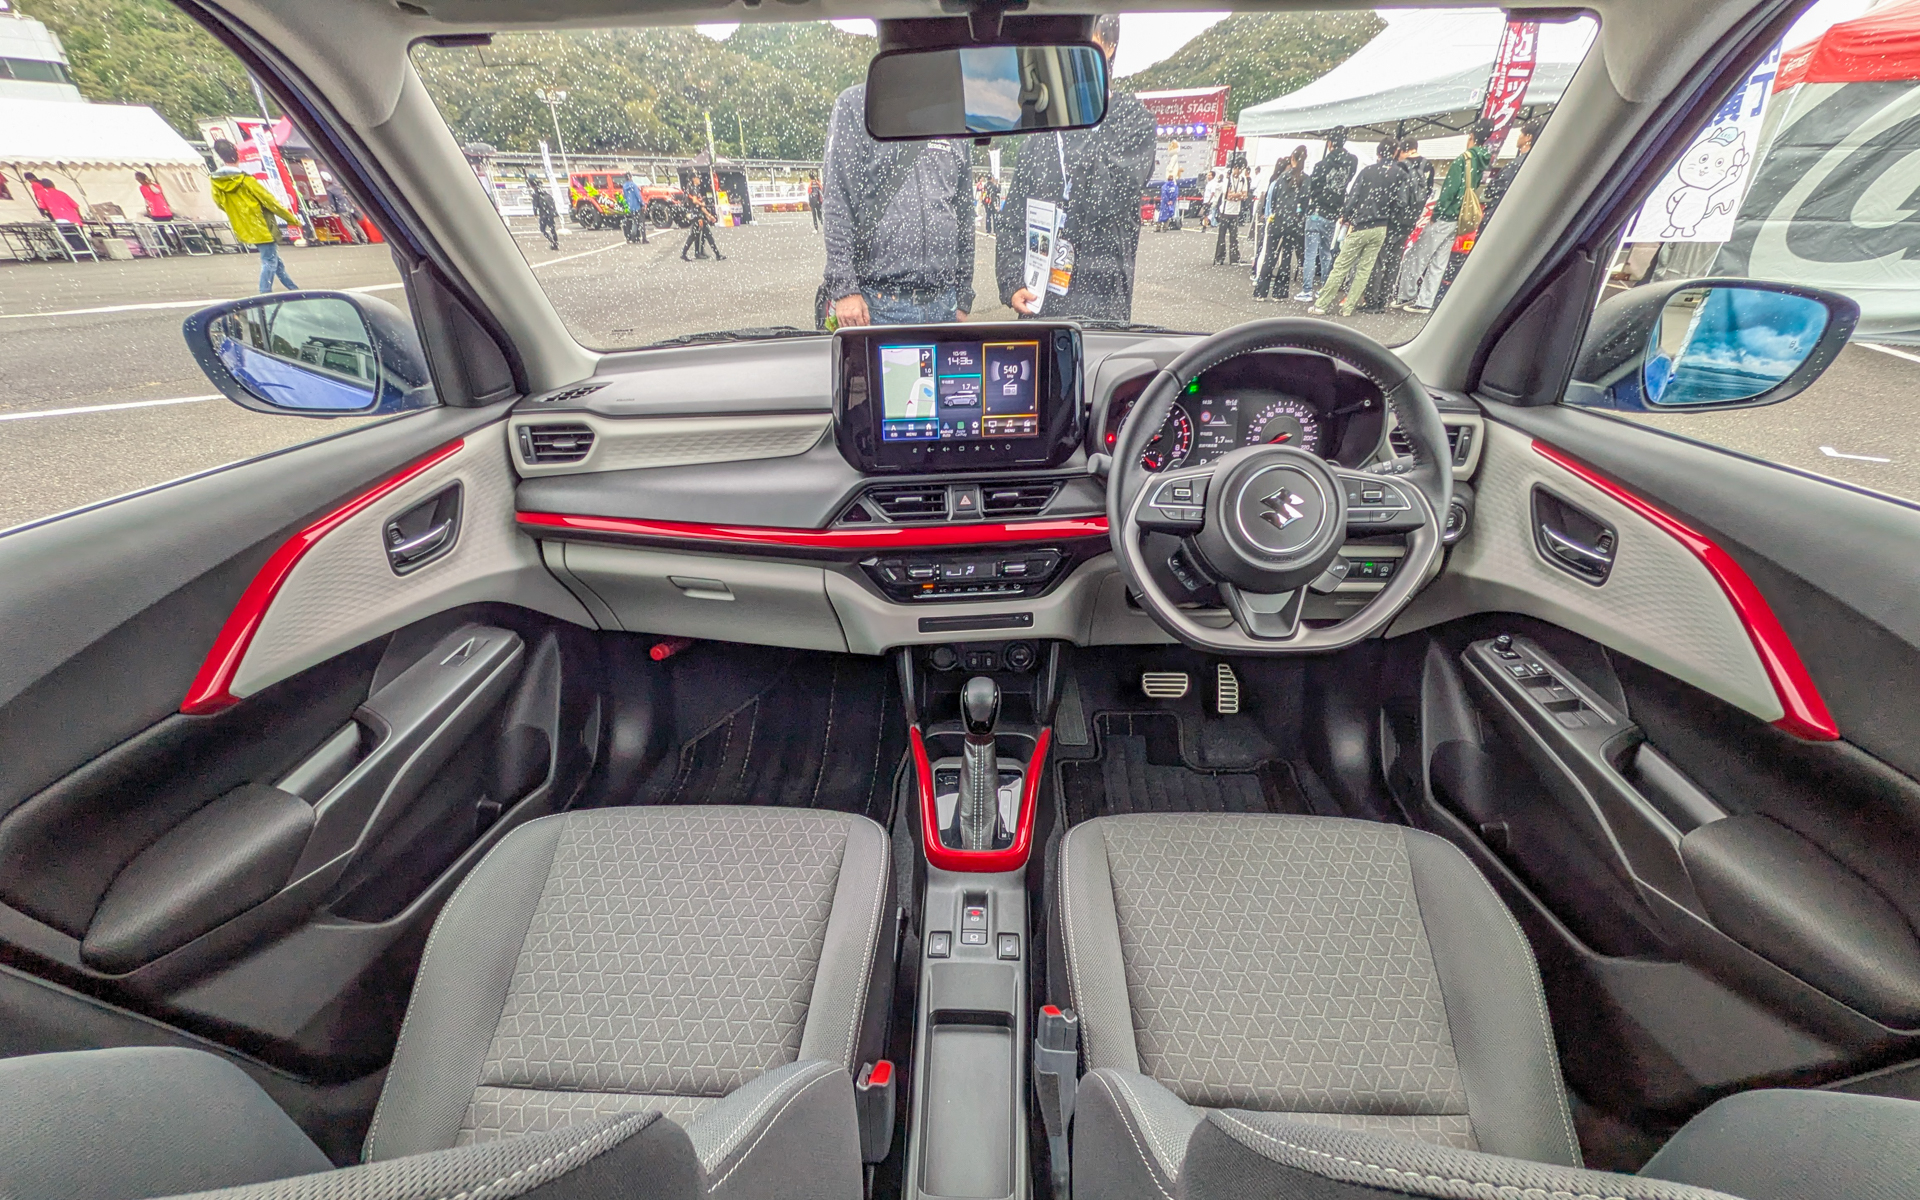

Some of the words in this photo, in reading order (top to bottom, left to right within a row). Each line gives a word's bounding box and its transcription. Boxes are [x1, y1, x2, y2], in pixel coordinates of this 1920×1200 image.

[1150, 104, 1184, 115] SPECIAL
[1186, 102, 1217, 113] STAGE
[1055, 246, 1068, 266] 2
[1003, 365, 1018, 374] 540
[1214, 436, 1225, 444] 1.7
